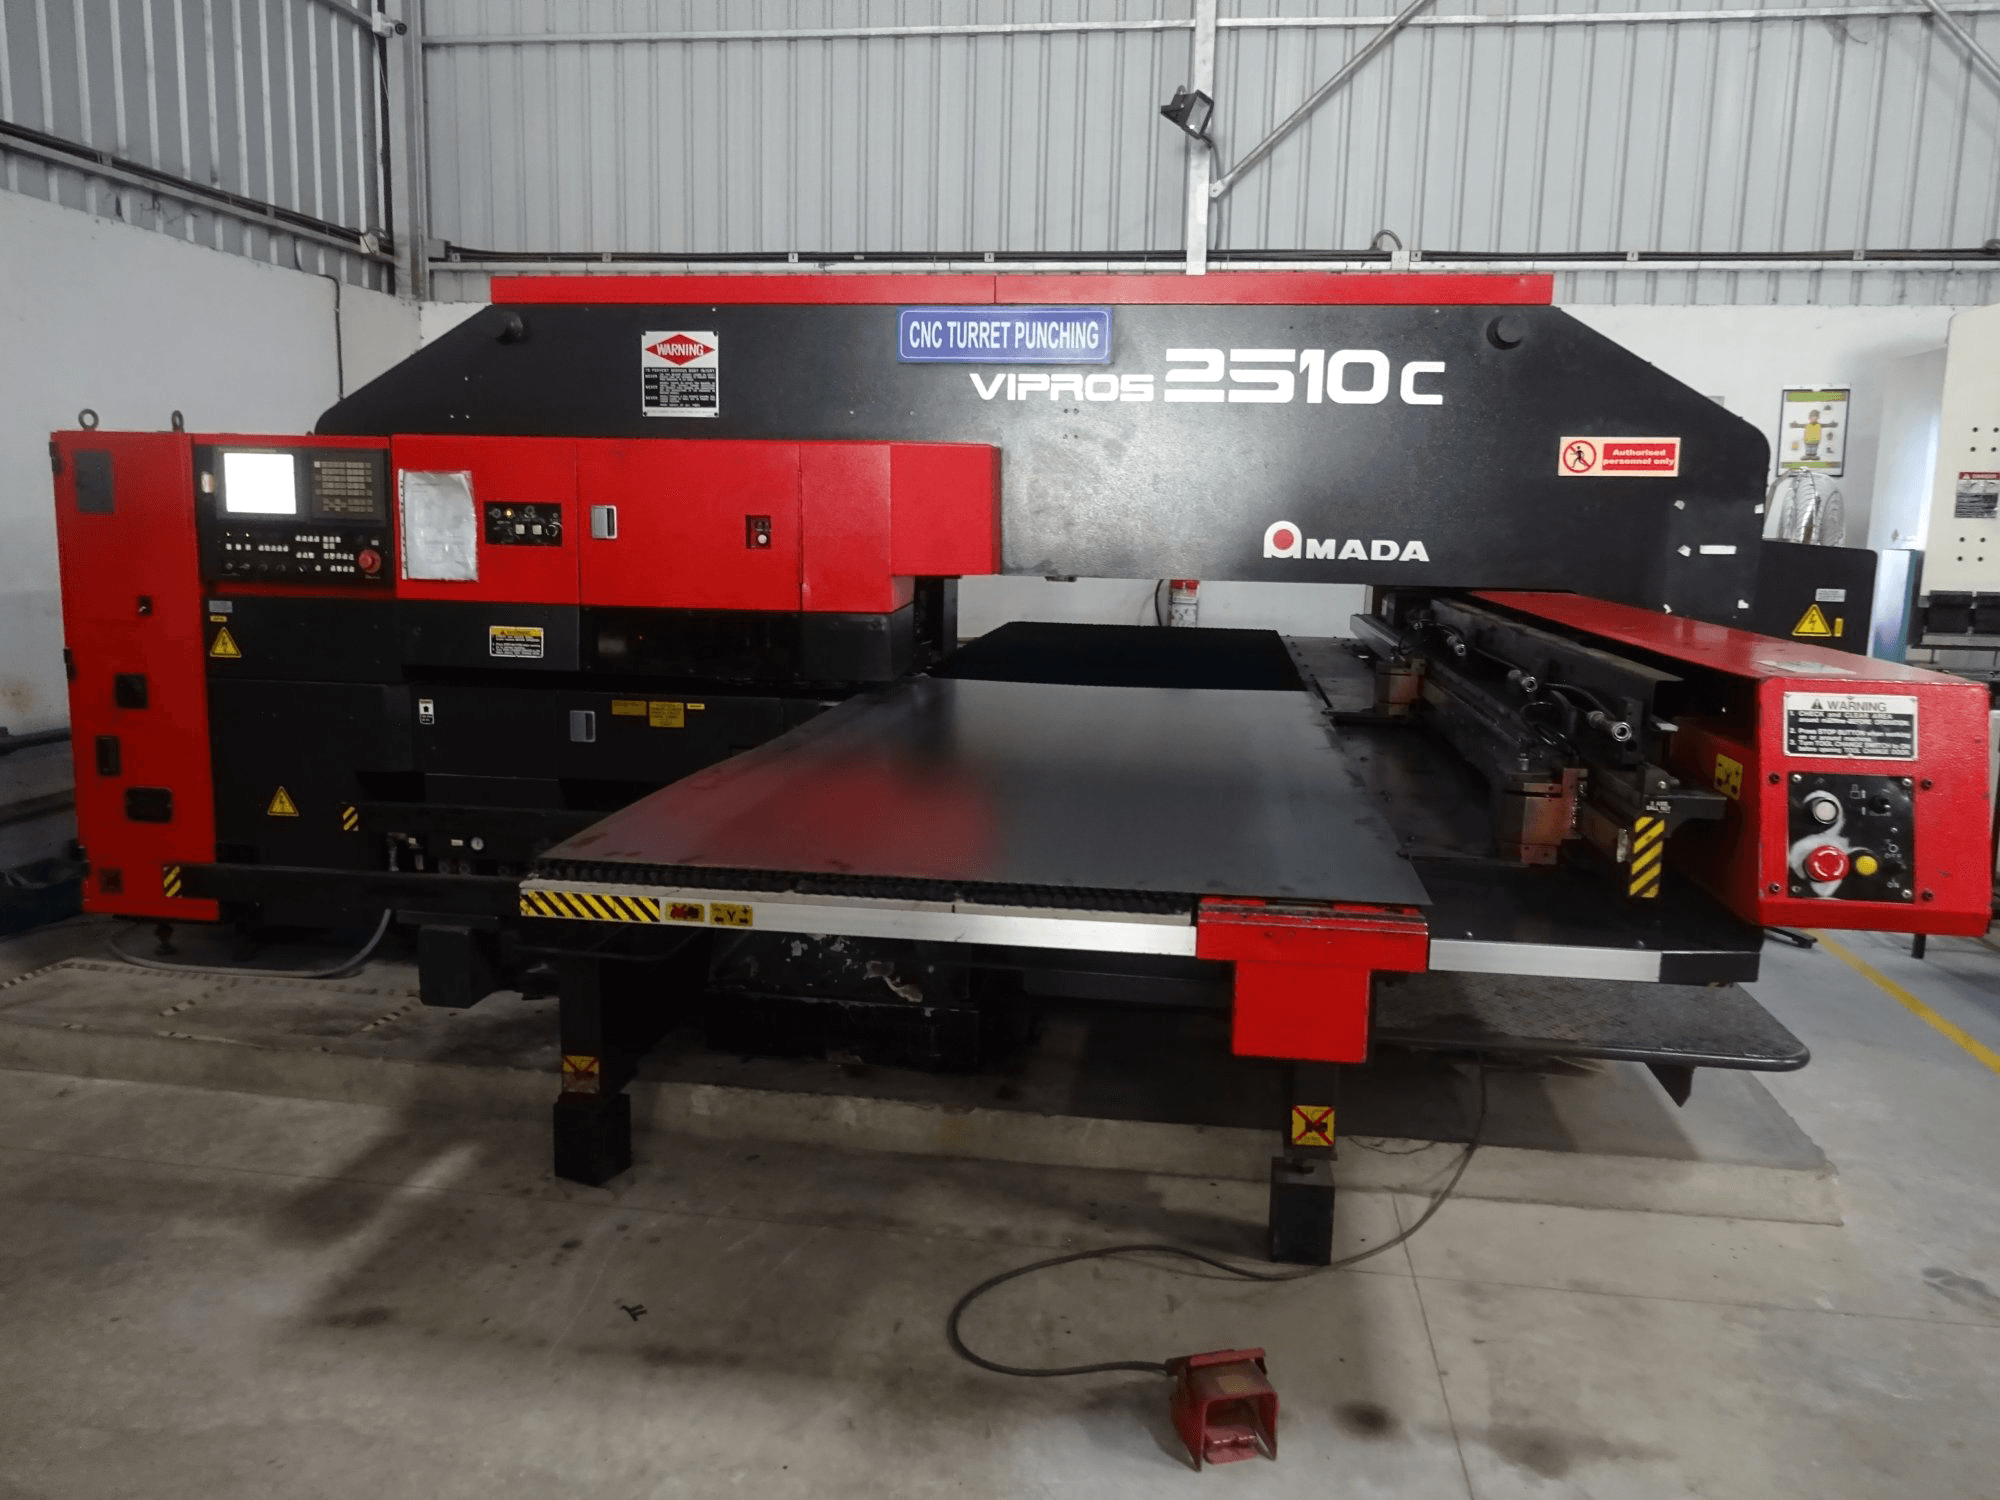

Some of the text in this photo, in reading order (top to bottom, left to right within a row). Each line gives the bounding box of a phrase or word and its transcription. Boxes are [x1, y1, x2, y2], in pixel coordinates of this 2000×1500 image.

[908, 320, 1099, 350] CNC TURRET PUNCHING
[656, 343, 704, 356] WARNING
[969, 373, 1154, 401] VIPROS
[1603, 458, 1674, 466] personnel only
[1827, 701, 1887, 712] WARNING
